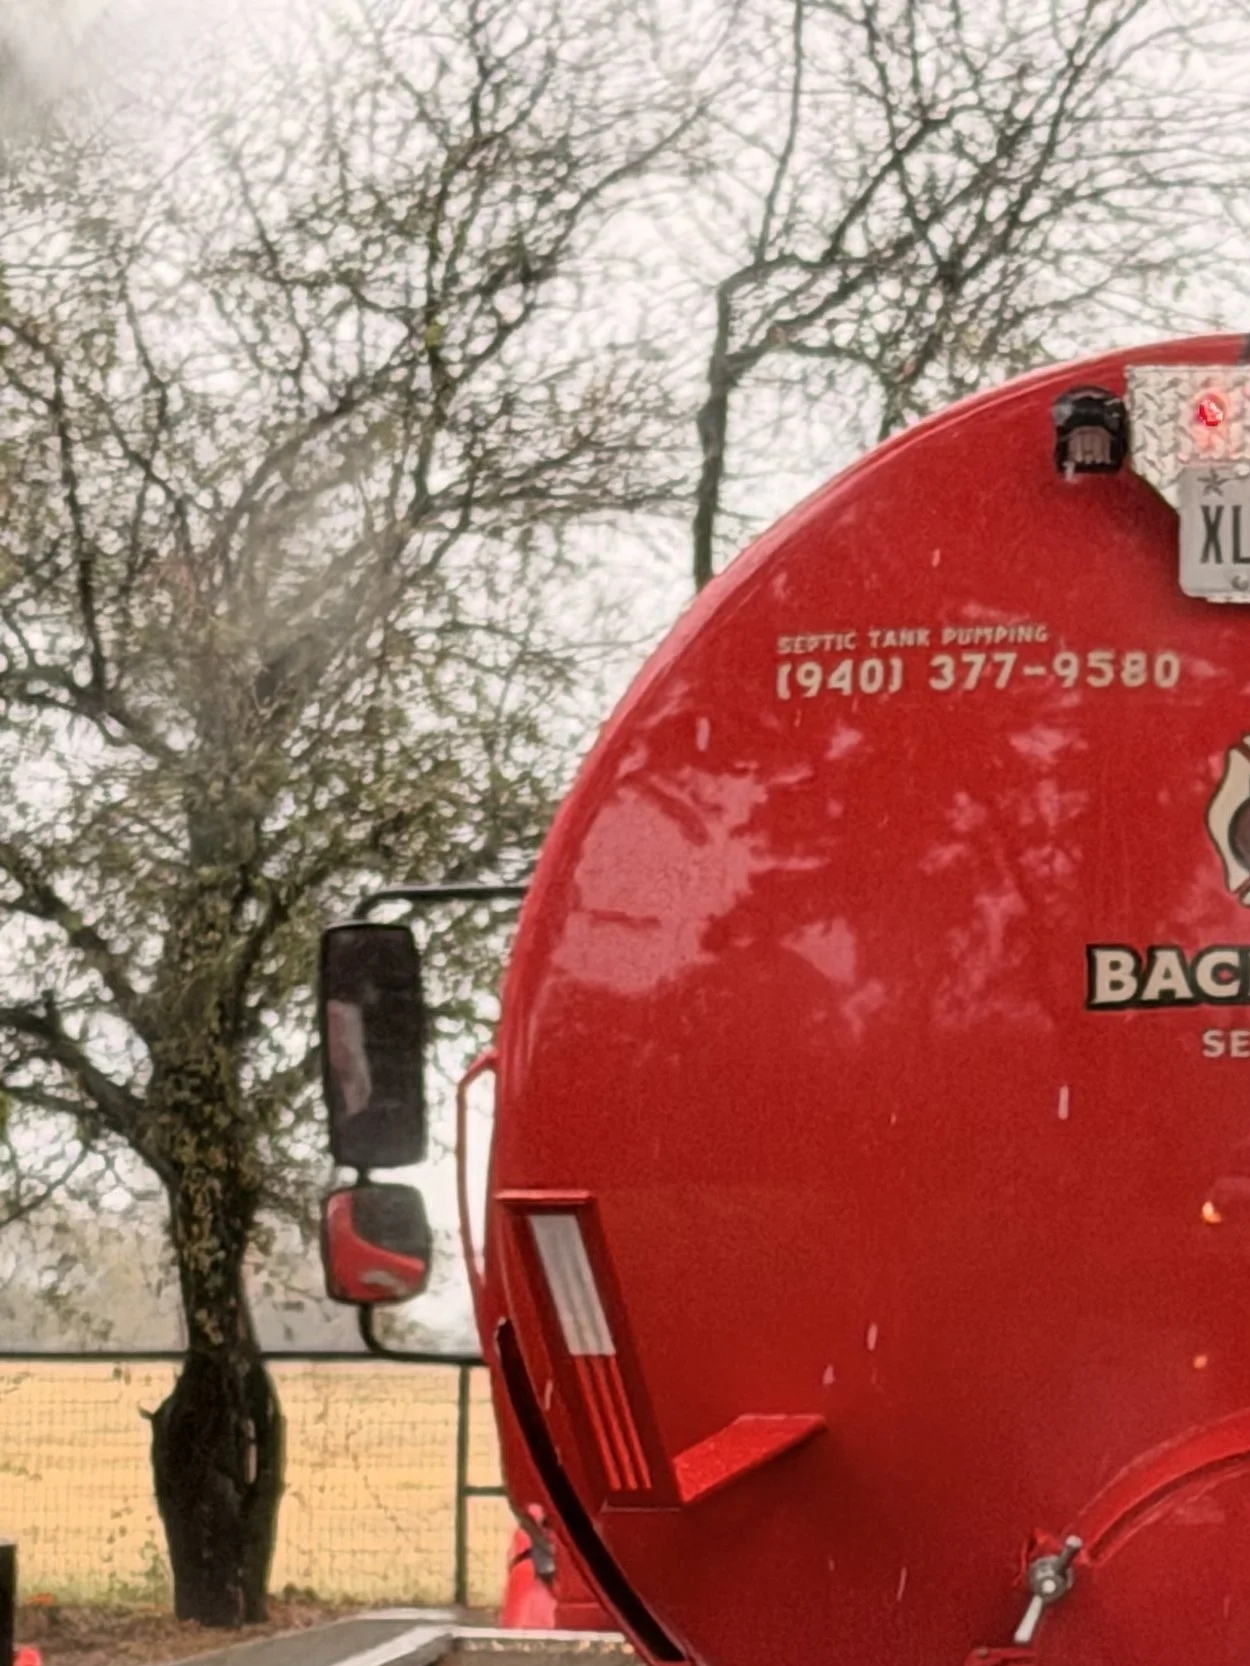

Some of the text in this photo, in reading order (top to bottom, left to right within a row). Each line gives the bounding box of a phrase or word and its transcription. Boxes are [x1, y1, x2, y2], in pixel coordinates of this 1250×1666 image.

[776, 624, 1049, 654] SEPTIC TANK PUMPING
[777, 650, 1181, 699] (940) 377-9580
